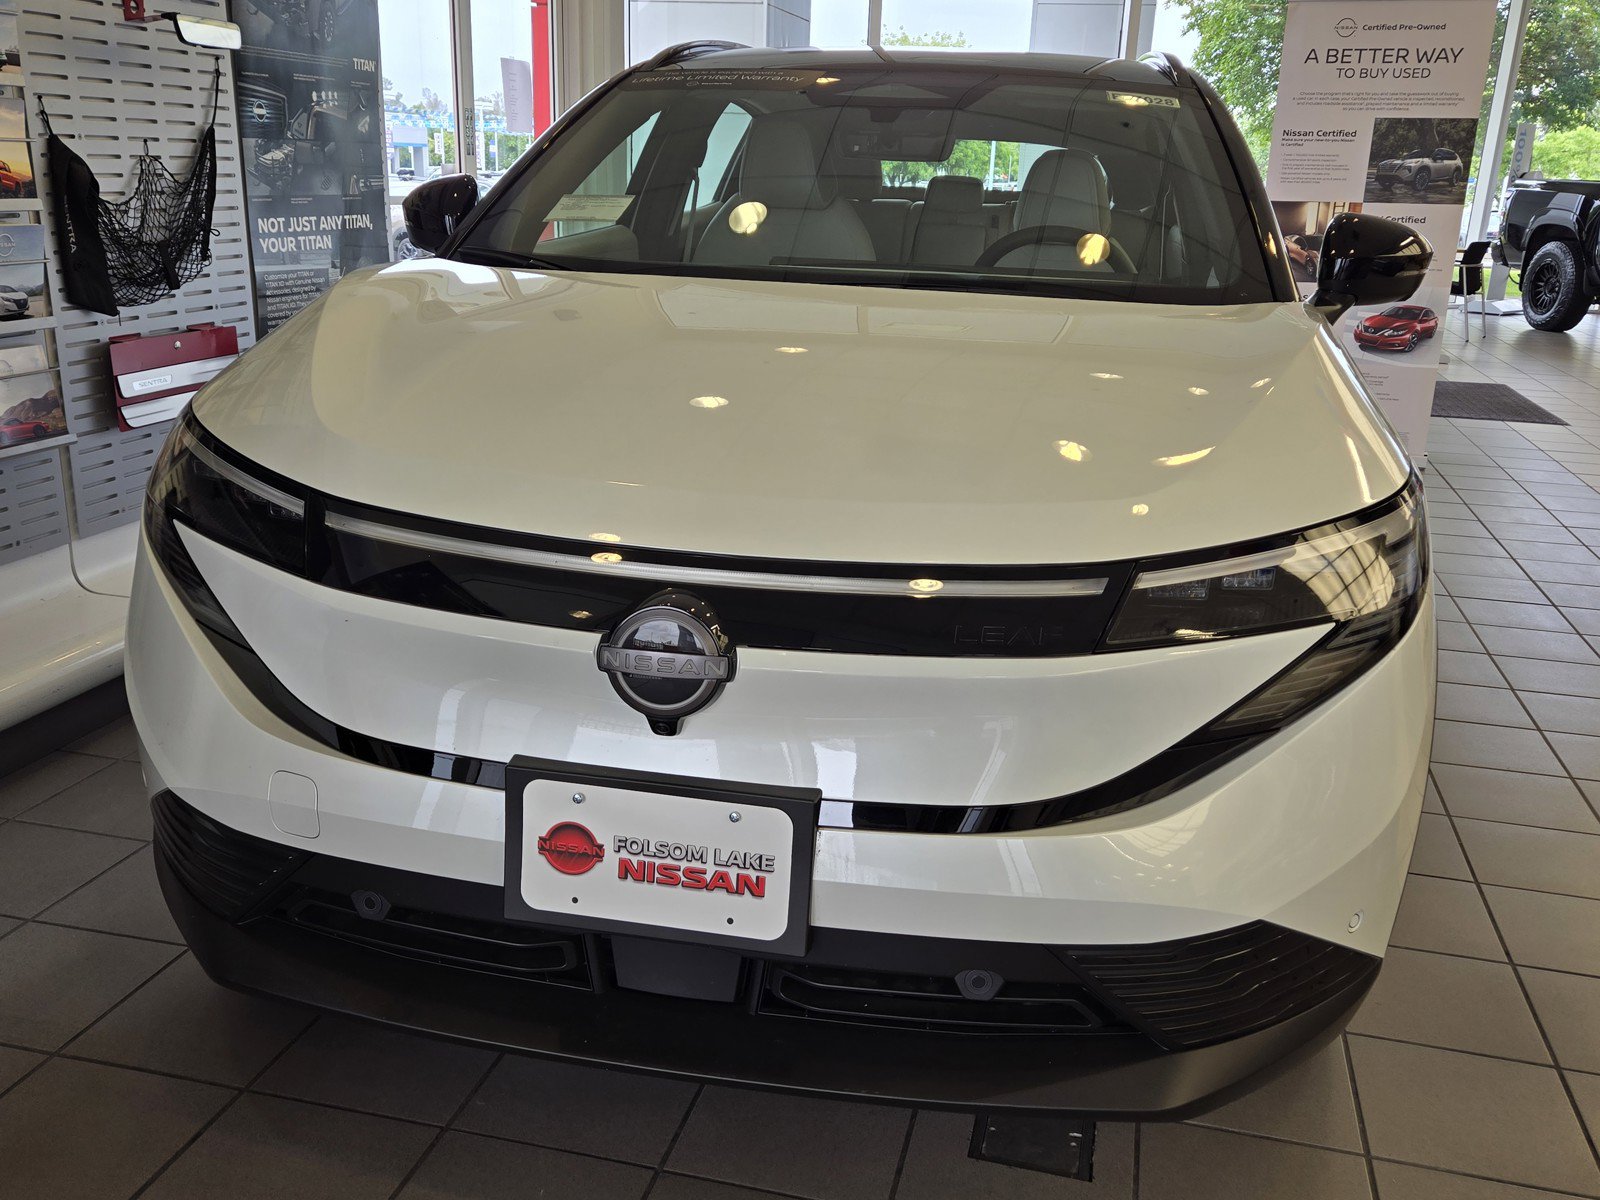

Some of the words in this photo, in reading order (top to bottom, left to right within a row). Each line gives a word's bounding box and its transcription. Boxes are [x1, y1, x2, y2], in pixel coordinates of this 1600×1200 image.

[1362, 23, 1397, 31] Certified
[1399, 23, 1447, 31] Pre-Owned
[1304, 48, 1319, 64] A
[1325, 47, 1410, 64] BETTER
[1416, 47, 1464, 63] WAY
[352, 57, 375, 72] TITAN
[632, 75, 685, 84] Lifetime
[740, 75, 805, 83] Warranty
[1336, 67, 1356, 79] TO
[1359, 67, 1389, 79] BUY
[1392, 67, 1431, 79] USED
[1283, 129, 1314, 137] Nissan
[1316, 129, 1357, 138] Certified
[257, 217, 285, 234] NOT
[288, 216, 317, 233] JUST
[320, 215, 343, 231] ANY
[344, 213, 373, 230] TITAN,
[259, 237, 297, 254] YOUR
[298, 234, 333, 251] TITAN
[264, 273, 287, 281] Customize
[295, 277, 311, 285] Genuine
[138, 377, 169, 388] SENTRA
[953, 624, 1064, 647] LEAF
[602, 650, 726, 677] NISSAN
[537, 837, 605, 859] NISSAN
[613, 834, 708, 864] FOLSOM
[713, 847, 776, 873] LAKE
[617, 856, 767, 898] NISSAN
